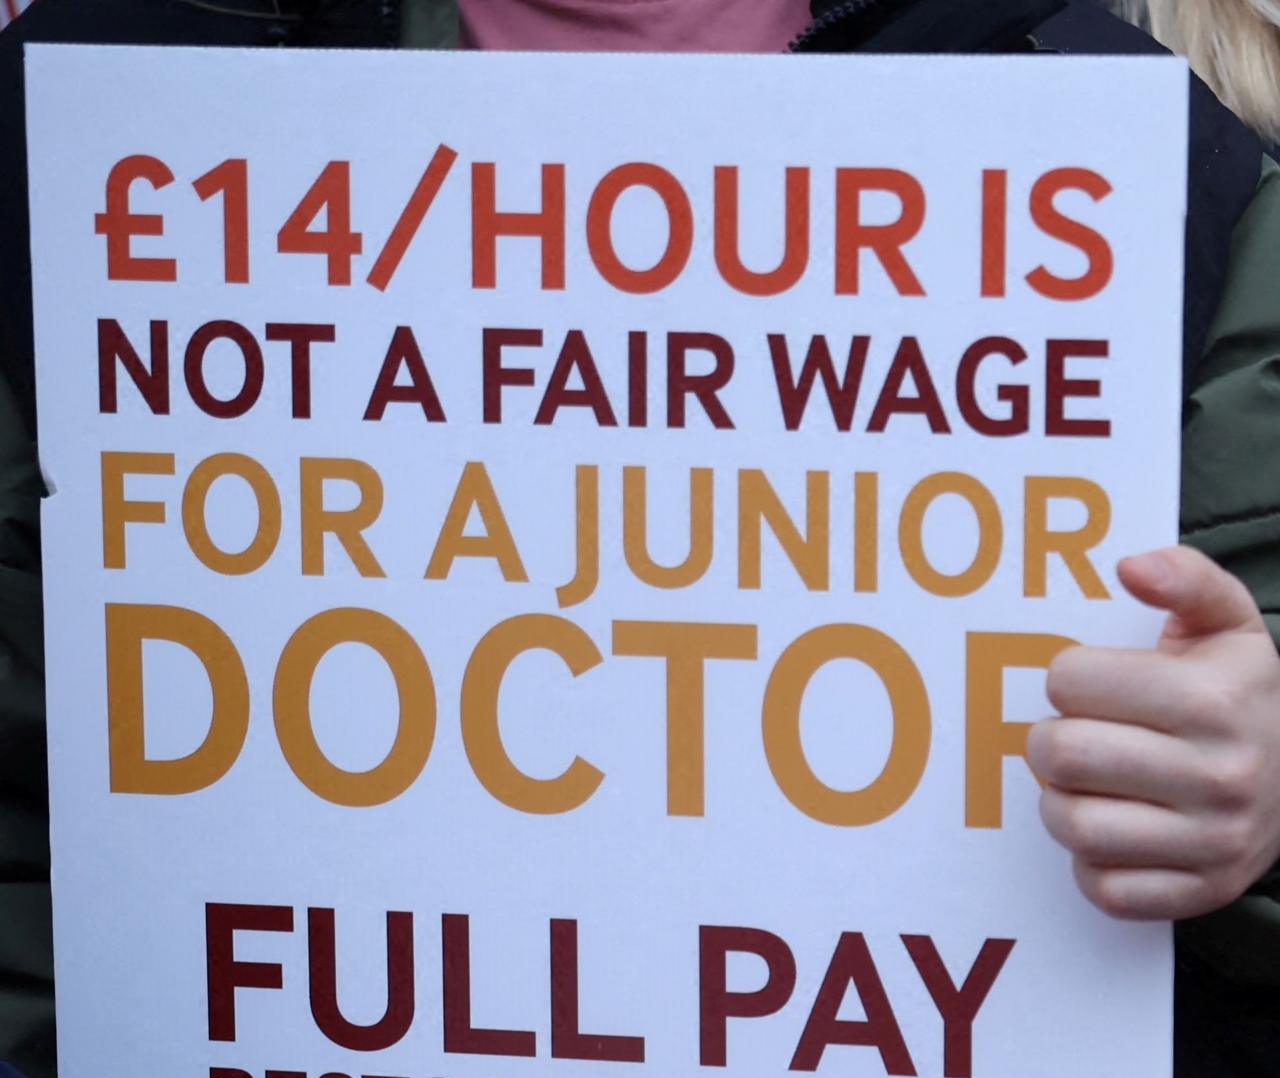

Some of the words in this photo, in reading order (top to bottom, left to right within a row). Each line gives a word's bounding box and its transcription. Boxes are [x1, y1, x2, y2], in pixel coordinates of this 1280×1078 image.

[95, 144, 927, 297] £14/HOUR
[980, 166, 1114, 302] IS
[97, 318, 335, 419] NOT
[362, 325, 446, 422] A
[481, 327, 735, 429] FAIR
[766, 334, 1111, 438] WAGE
[100, 450, 385, 578] FOR
[425, 460, 529, 582] A
[555, 463, 1112, 608] JUNIOR
[204, 902, 646, 1064] FULL
